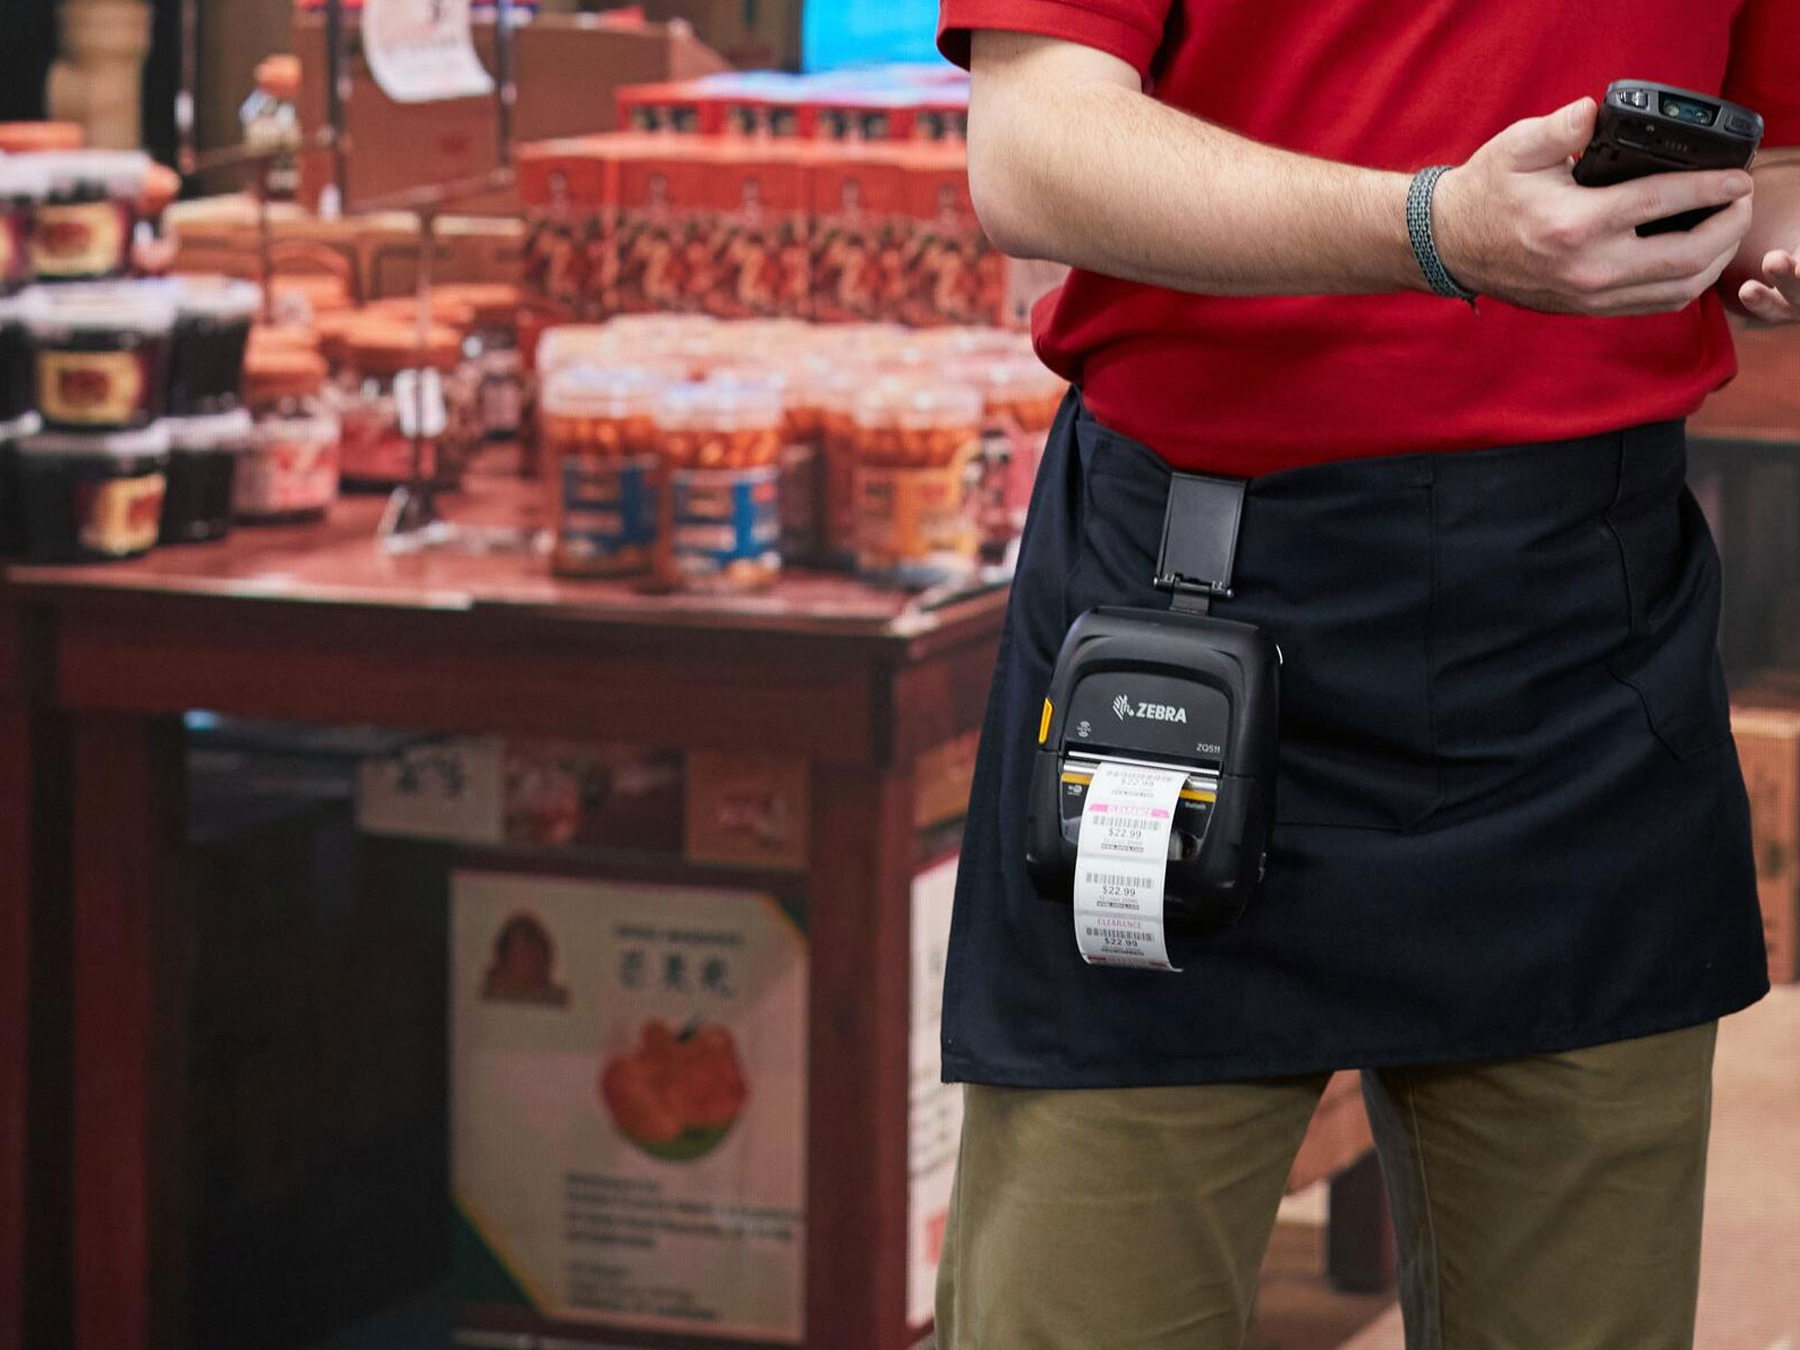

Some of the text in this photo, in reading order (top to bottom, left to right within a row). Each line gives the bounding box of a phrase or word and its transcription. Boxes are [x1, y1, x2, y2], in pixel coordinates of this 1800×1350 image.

[1136, 702, 1187, 723] ZEBRA
[1196, 743, 1221, 754] ZQ511
[1102, 885, 1136, 897] $22.99
[1104, 937, 1138, 947] $22.99
